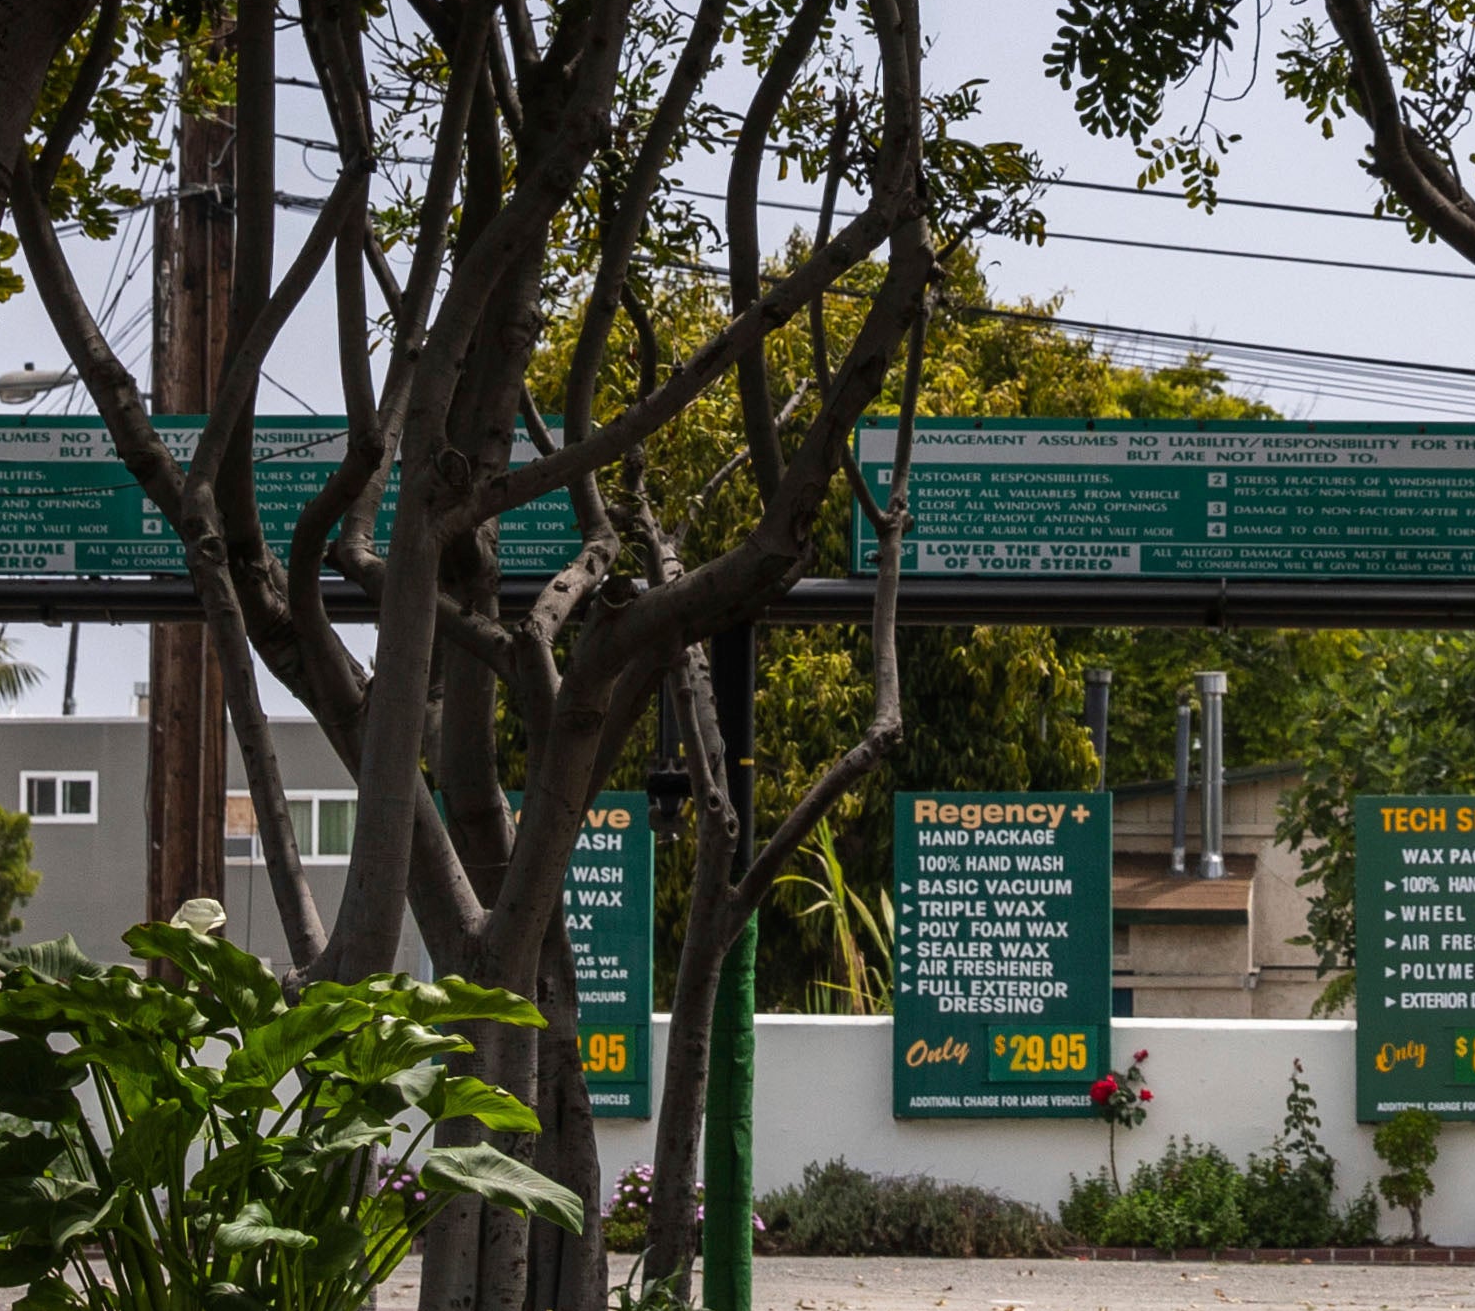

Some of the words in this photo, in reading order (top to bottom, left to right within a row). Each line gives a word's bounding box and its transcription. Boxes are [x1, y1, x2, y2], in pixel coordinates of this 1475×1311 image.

[61, 433, 91, 443] NO
[912, 435, 1026, 445] ANAGEMENT
[1038, 436, 1118, 446] ASSUMES
[1130, 436, 1158, 446] NO
[1411, 440, 1446, 450] FOR
[60, 447, 93, 457] BUT
[1127, 451, 1161, 460] BUT
[1172, 452, 1206, 461] ARE
[1217, 452, 1256, 461] NOT
[1267, 453, 1338, 463] LIMITED
[1213, 475, 1222, 484] 2
[1234, 476, 1277, 484] STRESS
[1285, 477, 1356, 485] FRACTURES
[1363, 477, 1380, 485] OF
[918, 489, 971, 497] REMOVE
[979, 490, 1001, 498] ALL
[1009, 489, 1076, 498] VALUABLES
[1085, 490, 1121, 498] FROM
[1129, 490, 1181, 499] VEHICLE
[1, 500, 29, 508] AND
[37, 500, 101, 508] OPENINGS
[994, 502, 1060, 510] WINDOWS
[1069, 503, 1096, 511] AND
[1104, 503, 1167, 511] OPENINGS
[1213, 504, 1221, 513] 3
[1234, 506, 1286, 514] DAMAGE
[1296, 506, 1314, 515] TO
[918, 514, 1035, 523] RETRACT/REMOVE
[1044, 515, 1110, 523] ANTENNAS
[88, 546, 108, 554] ALL
[116, 546, 168, 554] ALLEGED
[926, 544, 995, 555] LOWER
[1005, 545, 1046, 556] THE
[1050, 545, 1130, 557] VOLUME
[944, 558, 969, 568] OF
[979, 558, 1031, 569] YOUR
[1041, 558, 1112, 570] STEREO
[914, 799, 1066, 829] Regency
[1381, 808, 1446, 831] TECH
[575, 833, 622, 850] ASH
[919, 831, 968, 845] HAND
[976, 830, 1055, 845] PACKAGE
[919, 856, 961, 872] 100%
[966, 856, 1010, 872] HAND
[1017, 856, 1064, 872] WASH
[1402, 849, 1444, 864] WAX
[573, 866, 623, 883] WASH
[918, 880, 978, 894] BASIC
[986, 880, 1072, 895] VACUUM
[1401, 877, 1439, 893] 100%
[578, 891, 622, 907] WAX
[919, 902, 986, 916] TRIPLE
[994, 902, 1046, 916] WAX
[1401, 906, 1466, 921] WHEEL
[565, 914, 593, 929] AX
[919, 923, 960, 937] POLY
[971, 923, 1020, 937] FOAM
[1027, 923, 1068, 937] WAX
[918, 943, 992, 957] SEALER
[1000, 943, 1049, 958] WAX
[1401, 935, 1429, 951] AIR
[577, 957, 595, 965] AS
[598, 957, 618, 965] WE
[601, 970, 628, 979] CAR
[918, 961, 947, 976] AIR
[954, 962, 1053, 977] FRESHENER
[918, 981, 964, 996] FULL
[971, 981, 1068, 997] EXTERIOR
[577, 992, 626, 1002] VACUUMS
[1401, 993, 1468, 1008] EXTERIOR
[939, 998, 1044, 1013] DRESSING
[906, 1037, 969, 1067] Only
[995, 1034, 1087, 1072] $29.95
[1375, 1040, 1426, 1072] Only
[589, 1094, 630, 1105] VEHICLES
[910, 1096, 961, 1107] ADDITIONAL
[964, 1096, 999, 1107] CHARGE
[1002, 1096, 1018, 1107] FOR
[1021, 1096, 1048, 1107] LARGE
